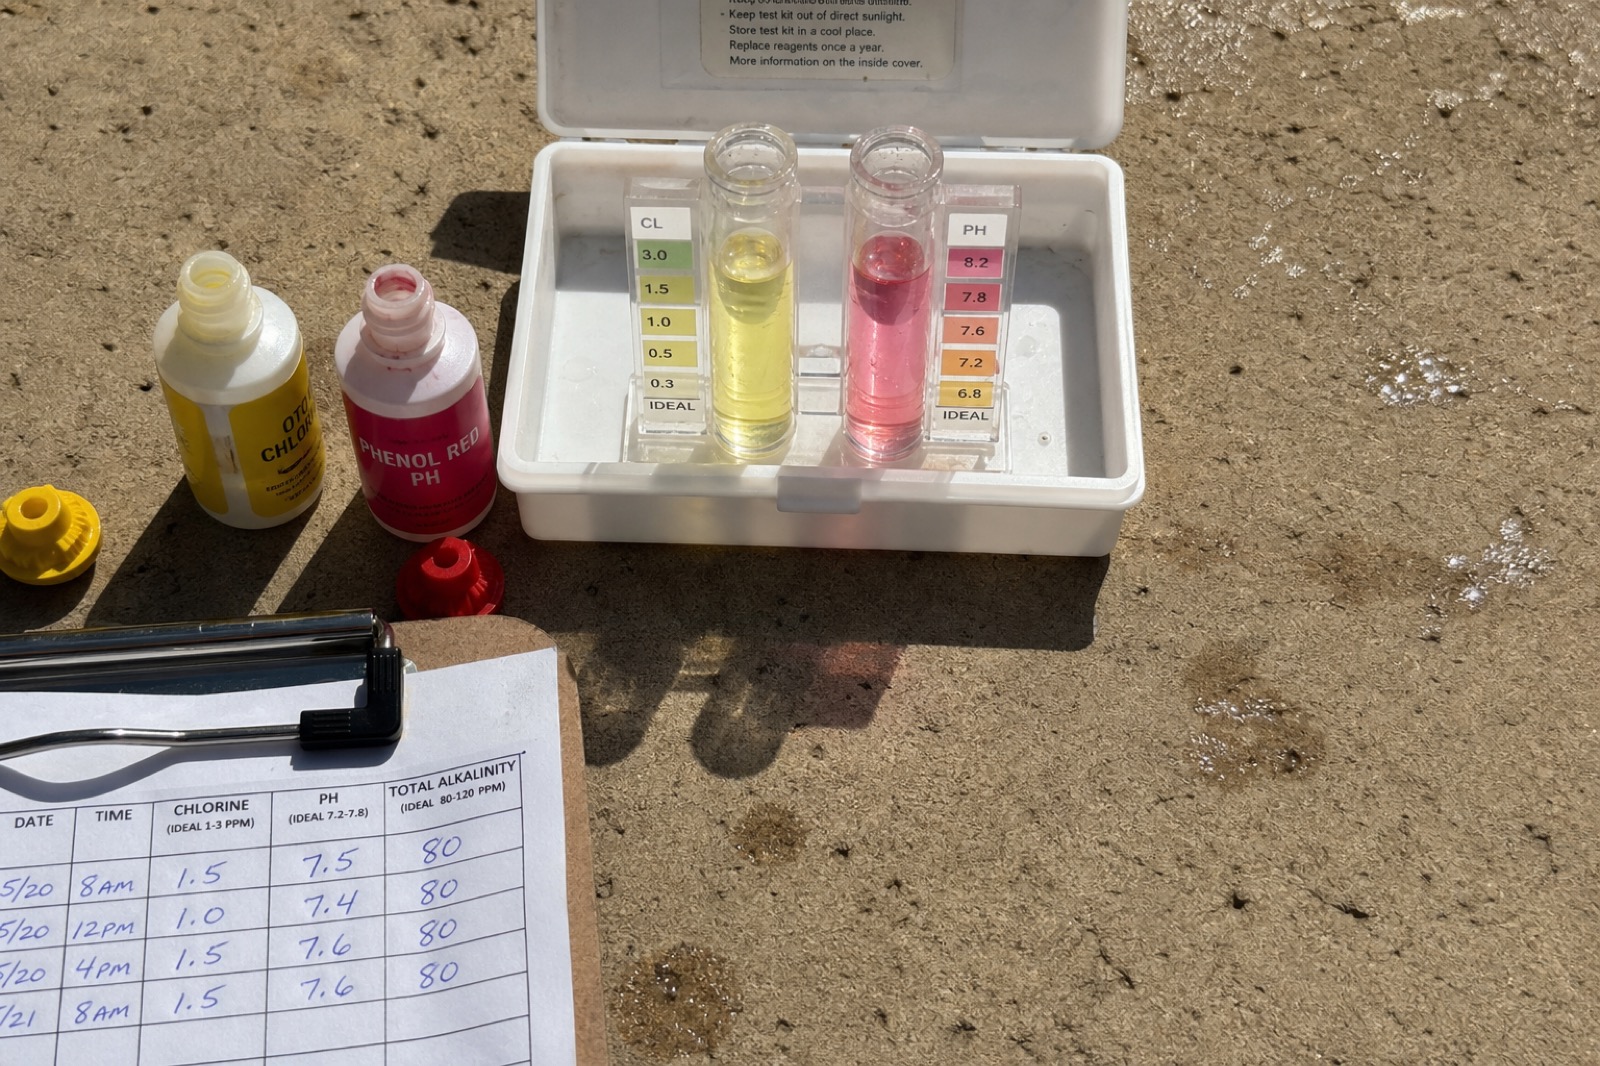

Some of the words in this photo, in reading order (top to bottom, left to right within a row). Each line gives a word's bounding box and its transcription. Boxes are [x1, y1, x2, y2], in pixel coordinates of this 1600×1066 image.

[729, 10, 756, 24] Keep
[759, 10, 778, 21] test
[781, 10, 794, 21] kit
[796, 11, 814, 21] out
[817, 10, 828, 21] of
[830, 10, 859, 22] direct
[862, 11, 906, 24] sunlight.
[728, 25, 756, 35] Store
[759, 26, 779, 35] test
[781, 25, 794, 36] kit
[797, 26, 807, 36] in
[810, 28, 817, 36] a
[820, 26, 842, 37] cool
[845, 26, 876, 38] place.
[729, 40, 771, 53] Replace
[774, 41, 818, 53] reagents
[821, 43, 846, 52] once
[849, 44, 856, 52] a
[859, 43, 885, 54] year.
[730, 56, 757, 66] More
[760, 56, 820, 67] information
[823, 58, 836, 67] on
[839, 56, 855, 67] the
[858, 57, 889, 68] inside
[892, 59, 923, 68] cover.
[640, 217, 663, 230] CL
[963, 224, 987, 236] PH
[642, 249, 667, 261] 3.0
[964, 257, 989, 268] 8.2
[644, 283, 669, 294] 1.5
[962, 292, 987, 303] 7.8
[647, 316, 671, 327] 1.0
[960, 325, 985, 336] 7.6
[648, 348, 673, 358] 0.5
[959, 358, 983, 368] 7.2
[650, 379, 674, 389] 0.3
[957, 388, 982, 399] 6.8
[282, 396, 308, 433] OTO
[650, 401, 696, 411] IDEAL
[943, 410, 990, 421] IDEAL
[359, 436, 441, 469] PHENOL
[446, 426, 479, 461] RED
[410, 469, 440, 487] PH
[388, 780, 434, 798] TOTAL
[438, 760, 517, 788] ALKALINITY
[319, 792, 339, 805] PH
[400, 799, 434, 814] (IDEAL
[440, 787, 475, 805] 80-120
[478, 781, 506, 796] PPM)
[95, 808, 133, 822] TIME
[173, 800, 250, 816] CHLORINE
[288, 813, 324, 825] (IDEAL
[327, 808, 369, 821] 7.2-7.8)
[14, 814, 54, 829] DATE
[166, 821, 202, 835] (IDEAL
[205, 820, 222, 831] 1-3
[225, 817, 255, 830] PPM)
[422, 836, 462, 864] 80
[303, 848, 359, 878] 7.5
[177, 861, 228, 889] 1.5
[0, 876, 53, 903] 5/20
[80, 874, 134, 898] 8AM
[420, 879, 459, 906] 80
[304, 889, 359, 918] 7.4
[176, 907, 225, 929] 1.0
[0, 918, 49, 945] 5/20
[72, 920, 134, 940] 12PM
[419, 918, 457, 947] 80
[299, 933, 352, 960] 7.6
[176, 941, 230, 971] 1.5
[75, 956, 131, 979] 4PM
[419, 961, 459, 989] 80
[300, 975, 354, 1001] 7.6
[174, 984, 227, 1014] 1.5
[0, 1004, 36, 1028] /21
[75, 1000, 130, 1025] 8AM
